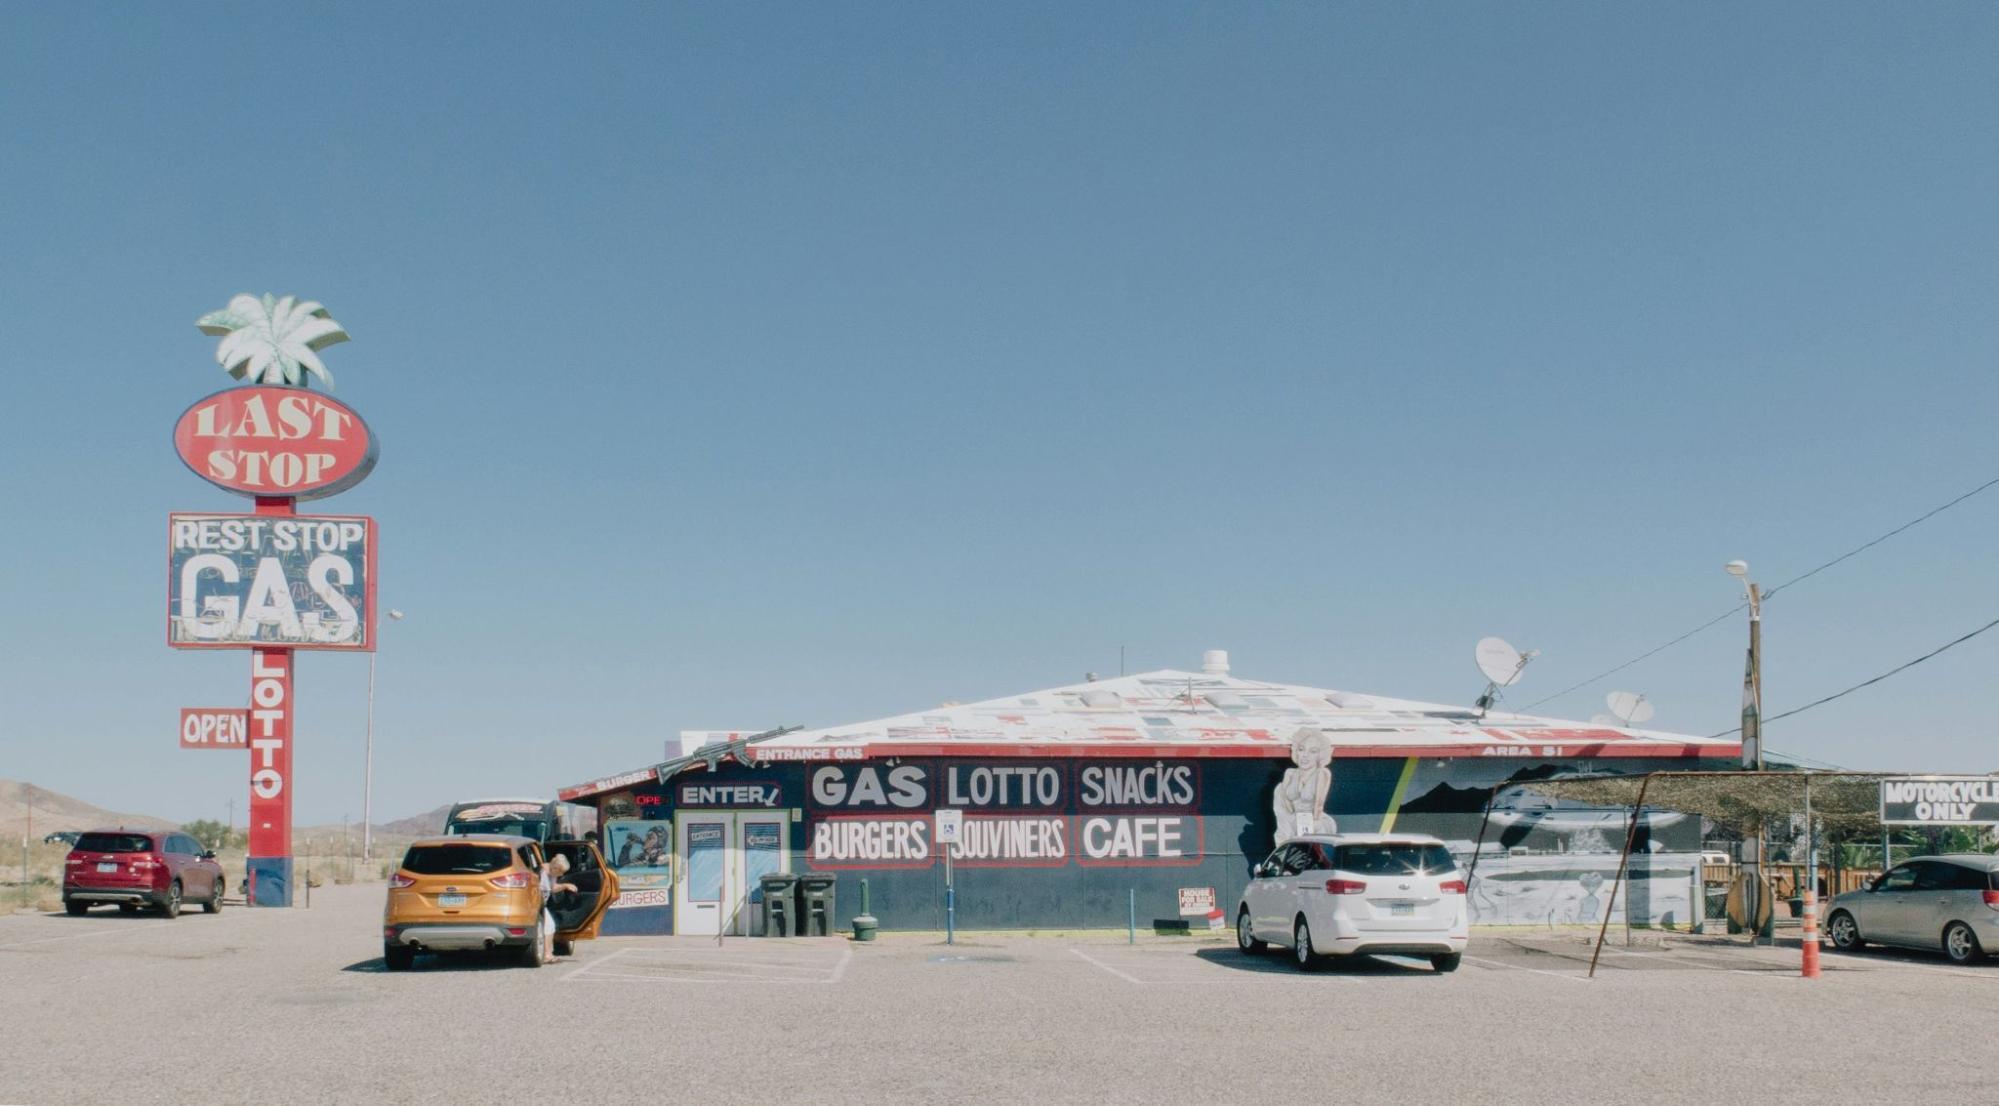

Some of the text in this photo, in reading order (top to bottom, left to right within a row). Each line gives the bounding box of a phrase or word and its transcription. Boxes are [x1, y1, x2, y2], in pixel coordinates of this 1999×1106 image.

[194, 394, 352, 441] LAST
[207, 450, 336, 487] STOP
[175, 520, 364, 551] REST STOP
[180, 553, 359, 642] GAS
[183, 713, 246, 744] OPEN
[253, 651, 285, 799] LOTTO
[756, 748, 863, 761] ENTRANCE GAS
[1481, 745, 1563, 757] AREA 51
[682, 786, 763, 804] ENTER
[812, 766, 927, 808] GAS
[948, 767, 1060, 806] LOTTO
[1080, 765, 1194, 806] SNACKS
[1915, 802, 1978, 820] ONLY
[814, 820, 929, 860] BURGERS
[1083, 818, 1182, 858] CAFE
[612, 890, 666, 906] URGERS
